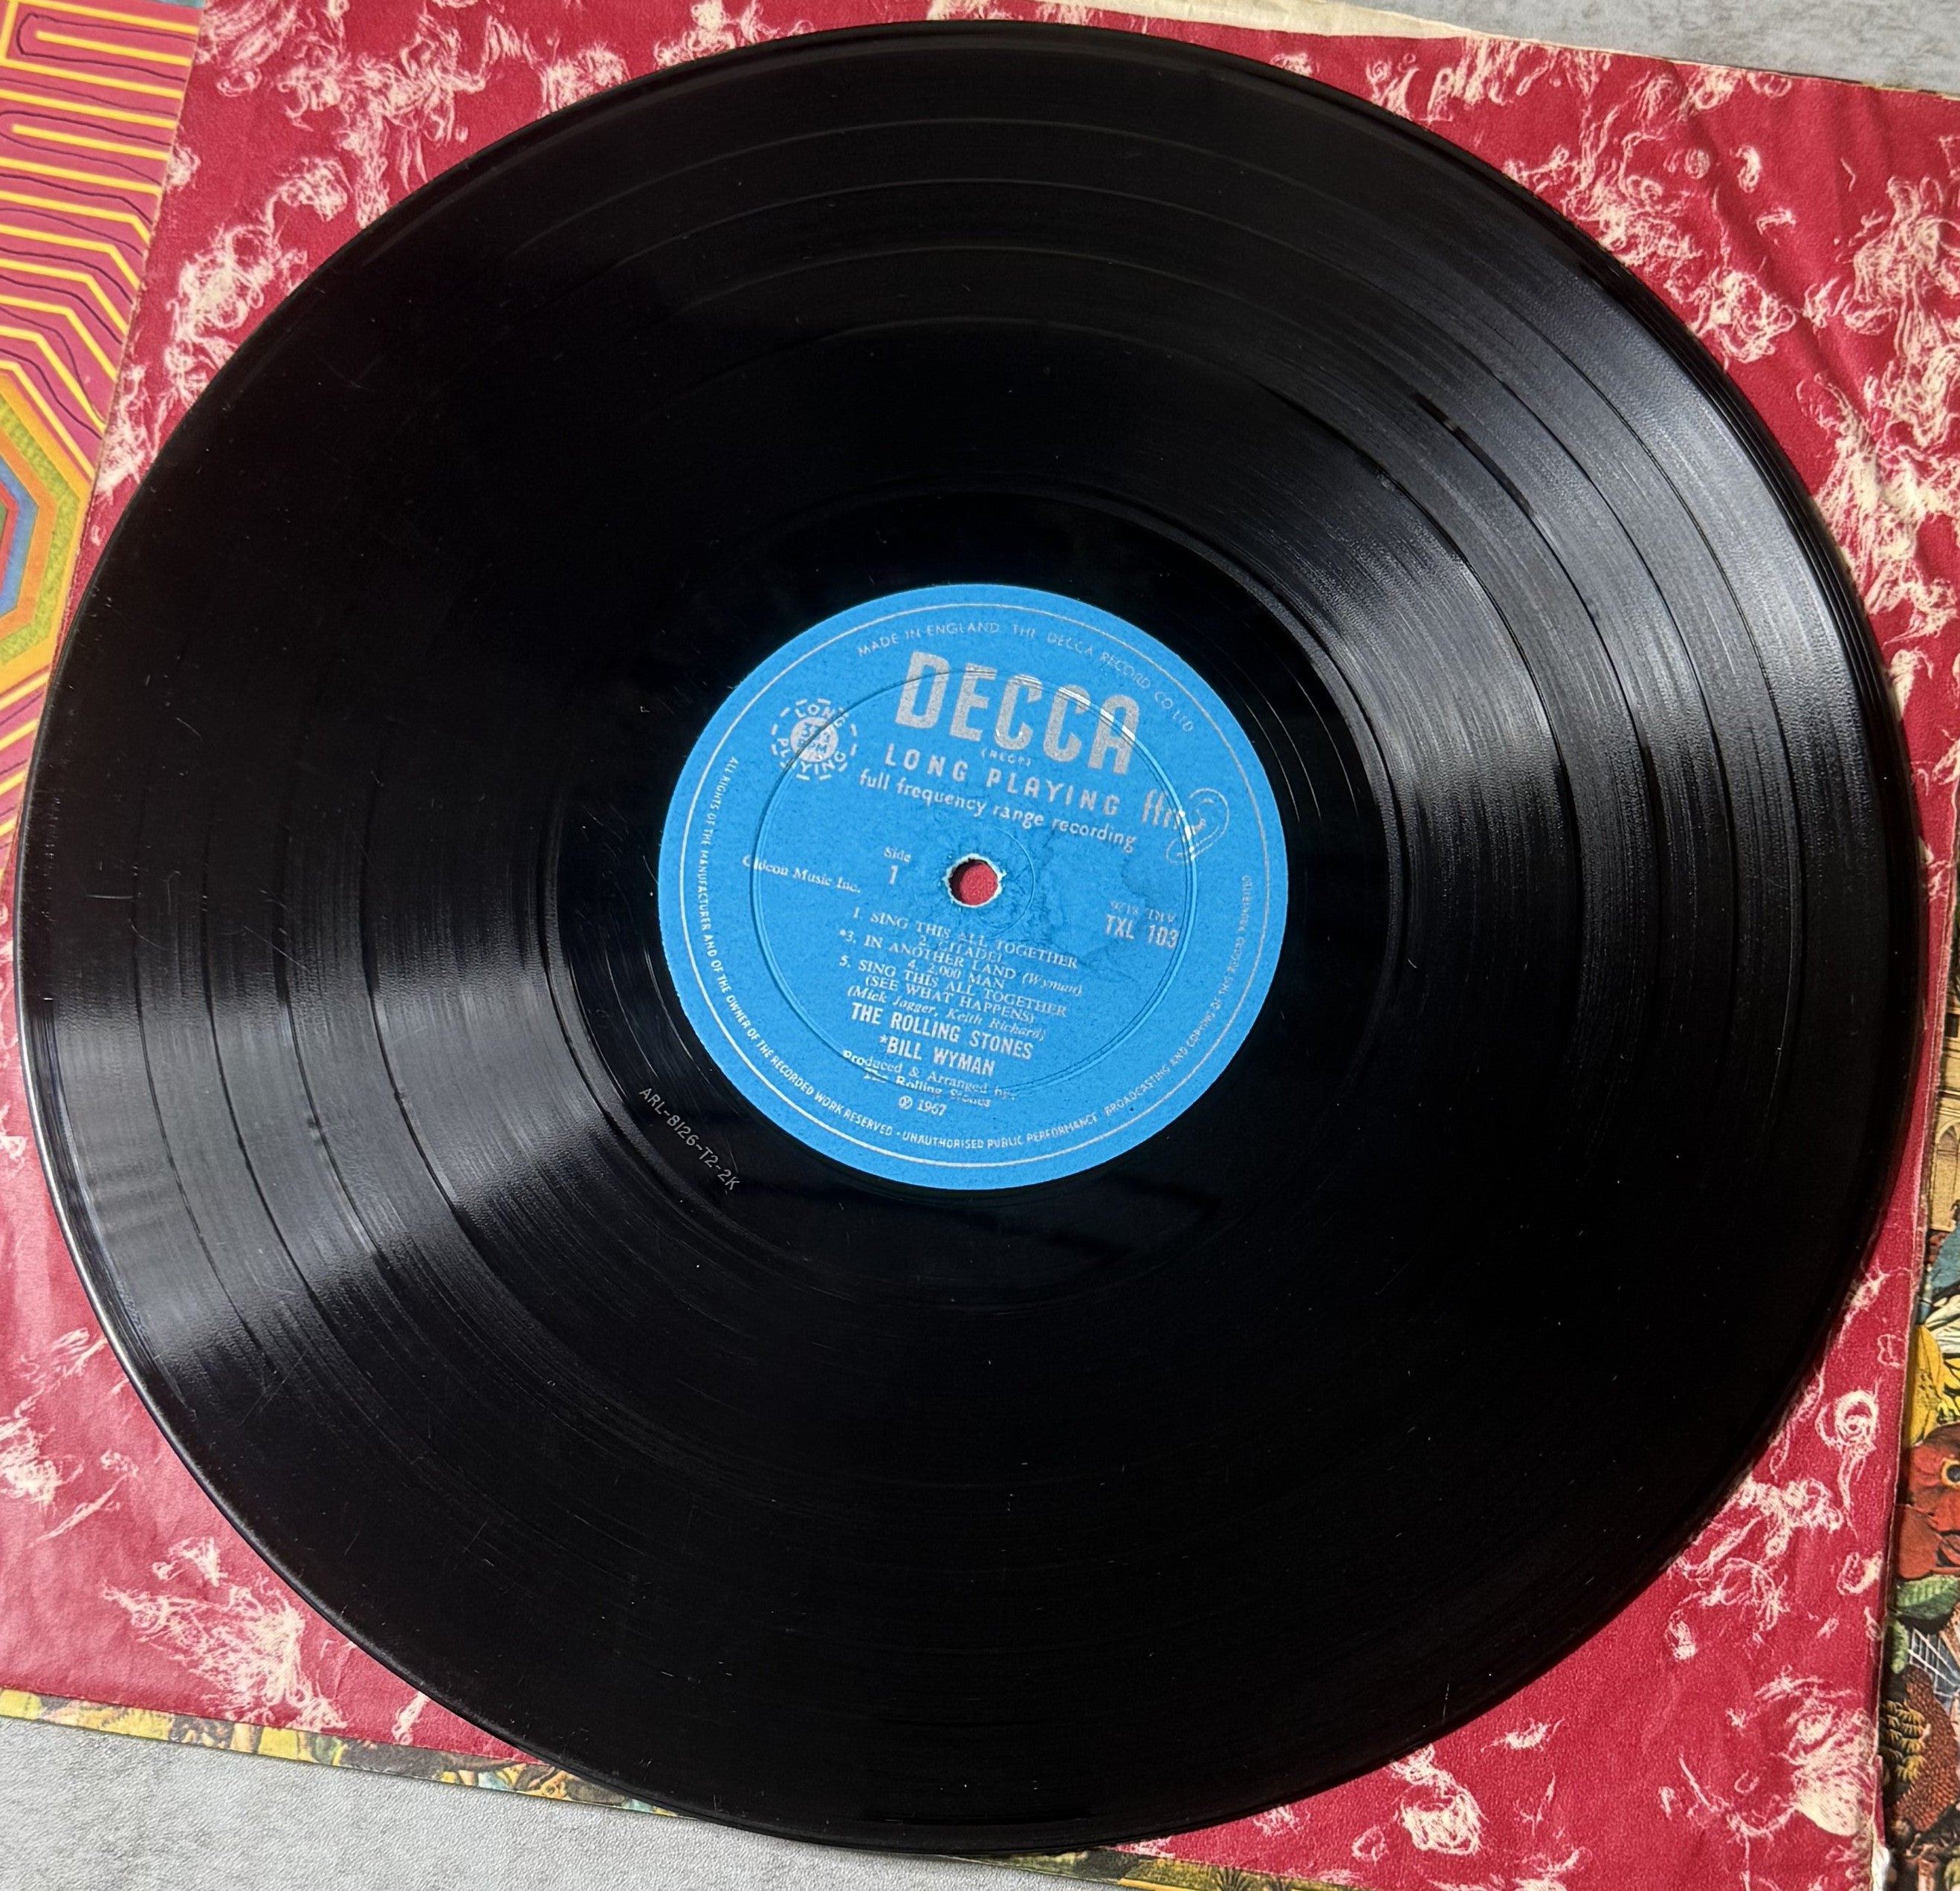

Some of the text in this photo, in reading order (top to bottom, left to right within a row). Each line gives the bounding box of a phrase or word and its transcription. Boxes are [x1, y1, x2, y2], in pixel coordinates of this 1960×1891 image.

[857, 622, 1000, 657] MADE IN ENGLAND
[1047, 633, 1094, 656] DECCA
[1099, 651, 1151, 689] RECORD
[795, 703, 847, 728] LONG
[894, 650, 1140, 775] DECCA
[884, 743, 1120, 816] LONG PLAYING
[858, 768, 1137, 853] full frequency range recording
[883, 846, 912, 864] Side
[888, 864, 899, 886] 1
[792, 866, 833, 888] Music
[835, 876, 861, 893] Inc.
[697, 755, 893, 1137] ALL RIGHTS OF THE MANUFACTURER AND OF THE OWNER OF THE RECORDED WORK RESERVED
[870, 911, 909, 930] SING
[915, 920, 951, 940] THIS
[958, 931, 988, 948] ALL
[995, 939, 1078, 969] TOGETHER
[938, 940, 1006, 964] CITADEL
[1105, 914, 1179, 949] TXL 103
[838, 954, 1067, 1018] 5. SING THIS ALL TOGETHER
[863, 934, 884, 949] IN
[888, 943, 965, 968] ANOTHER
[971, 959, 1017, 980] LAND
[1021, 972, 1083, 998] (Wyman)
[968, 972, 1006, 989] MAN
[847, 985, 1047, 1041] (Mick Jagger, Keith Richard)
[864, 974, 1035, 1024] (SEE WHAT HAPPENS)
[850, 1002, 1034, 1060] THE ROLLING STONES
[842, 1049, 903, 1074] Produced
[908, 1066, 920, 1078] &
[928, 1070, 989, 1094] Arranged
[932, 1047, 995, 1077] WYMAN
[1102, 1064, 1171, 1117] BROADCASTING
[1169, 1046, 1188, 1067] AND
[895, 1075, 942, 1096] Rolling
[916, 1099, 948, 1116] 1967
[902, 1112, 1099, 1149] UNAUTHORISED PUBLIC PERFORMANCE
